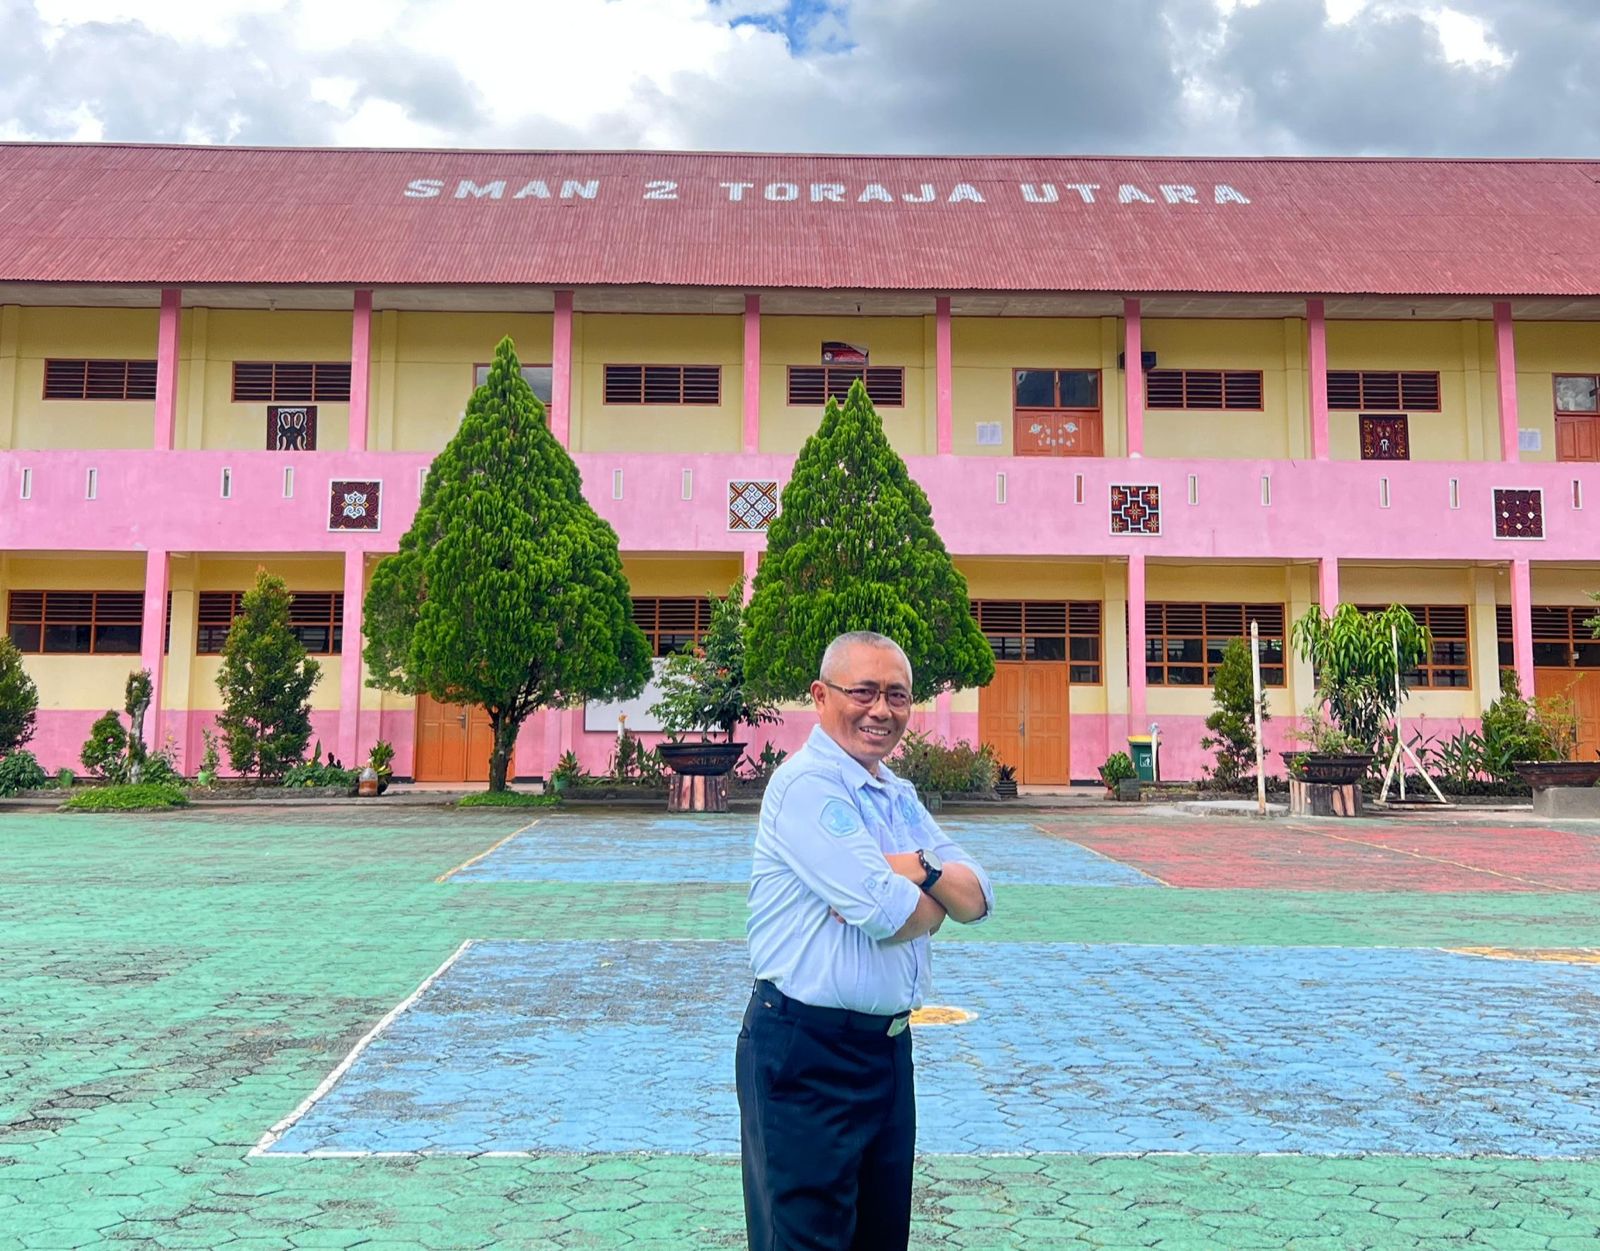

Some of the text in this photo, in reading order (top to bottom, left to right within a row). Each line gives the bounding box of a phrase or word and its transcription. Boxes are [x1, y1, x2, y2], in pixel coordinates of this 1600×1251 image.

[404, 178, 1251, 204] SMAN 2 TORAJA UTARA
